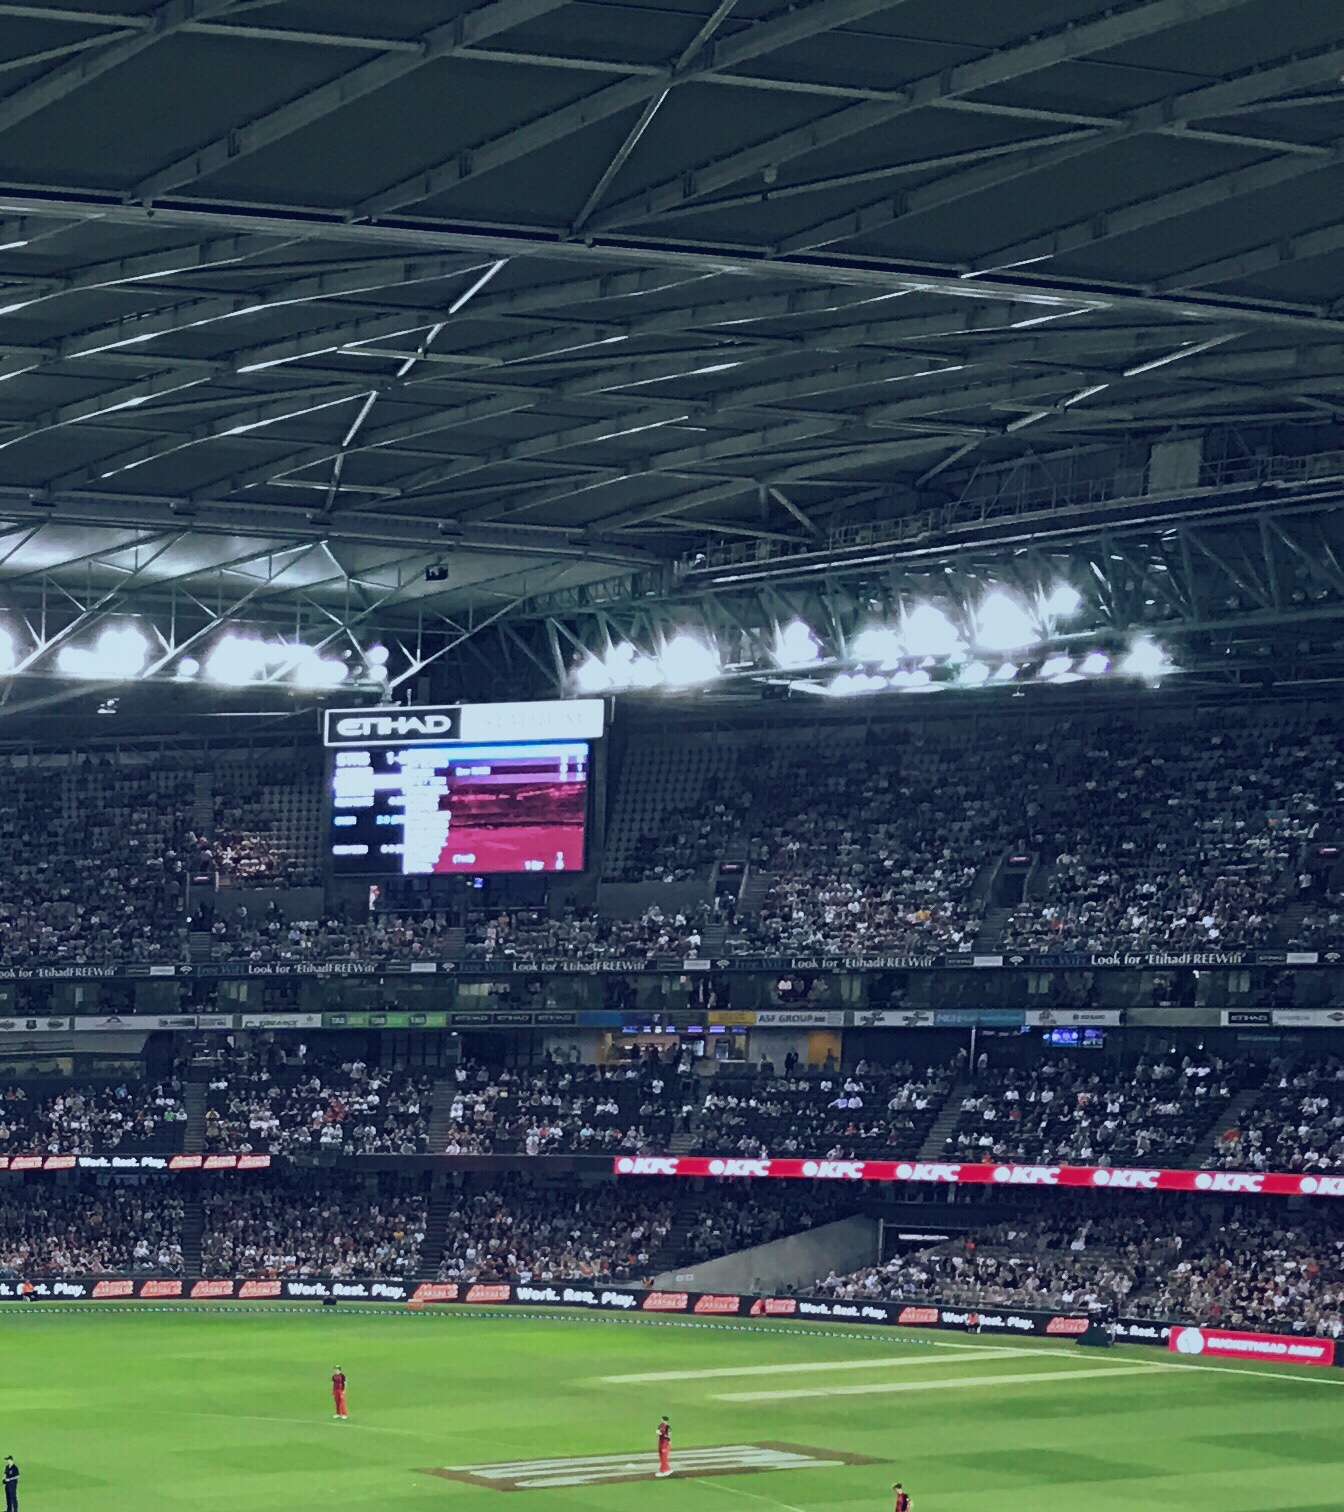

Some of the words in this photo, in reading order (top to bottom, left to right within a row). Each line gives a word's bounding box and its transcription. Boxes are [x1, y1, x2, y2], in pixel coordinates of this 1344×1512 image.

[336, 715, 451, 736] ETIHAD
[632, 1158, 679, 1174] KFC
[725, 1160, 771, 1176] KFC
[818, 1162, 864, 1178] KFC
[912, 1164, 960, 1181] KFC
[1010, 1166, 1060, 1184] KFC
[1108, 1170, 1160, 1188] KFC
[1211, 1174, 1264, 1192] KFC
[54, 1283, 86, 1297] Play.
[288, 1283, 330, 1295] Work.
[333, 1284, 368, 1295] Rest.
[372, 1284, 406, 1299] Play.
[517, 1288, 560, 1300] Work.
[602, 1292, 636, 1308] Play.
